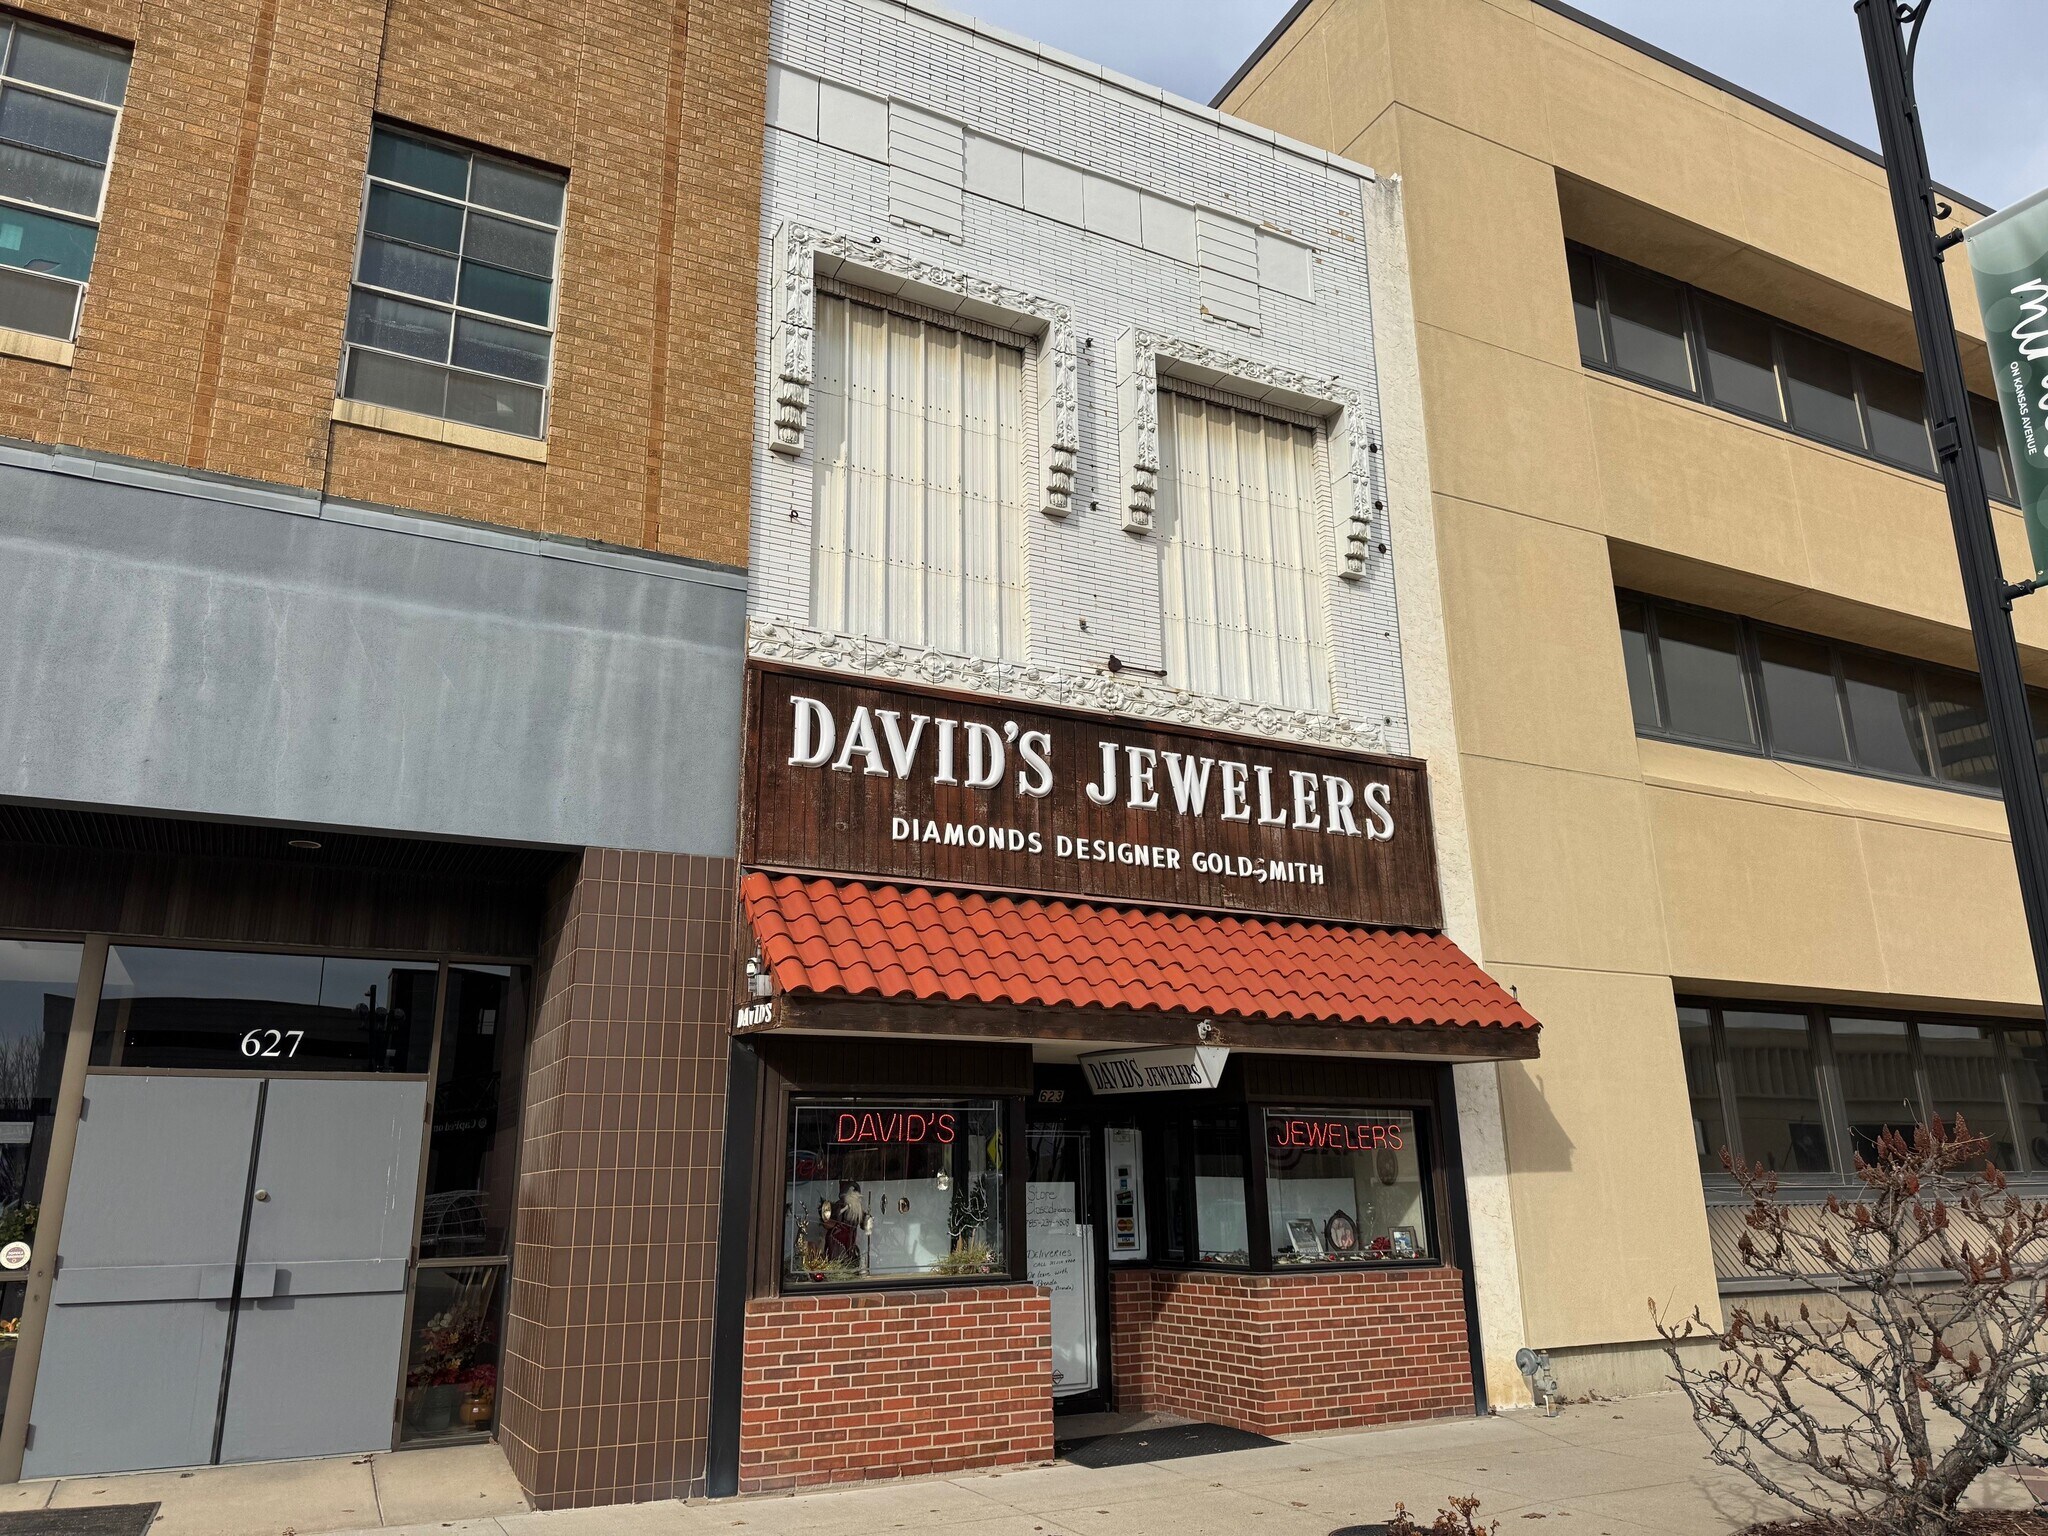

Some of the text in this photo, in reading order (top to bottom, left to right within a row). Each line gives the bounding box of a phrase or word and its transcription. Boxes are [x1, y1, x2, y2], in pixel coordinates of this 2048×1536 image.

[2010, 361, 2037, 456] ON KANSAS AVENUE
[788, 695, 1396, 842] DAVID'S JEWELERS
[892, 817, 1325, 886] DIAMONDS DESIGNER GOLDSMITH
[241, 1028, 304, 1058] 627
[1088, 1058, 1202, 1089] DAVID'S JEWELERS
[1040, 1090, 1063, 1102] 623
[838, 1112, 955, 1143] DAVID'S
[1277, 1120, 1403, 1150] JEWELERS
[1027, 1185, 1057, 1201] Store
